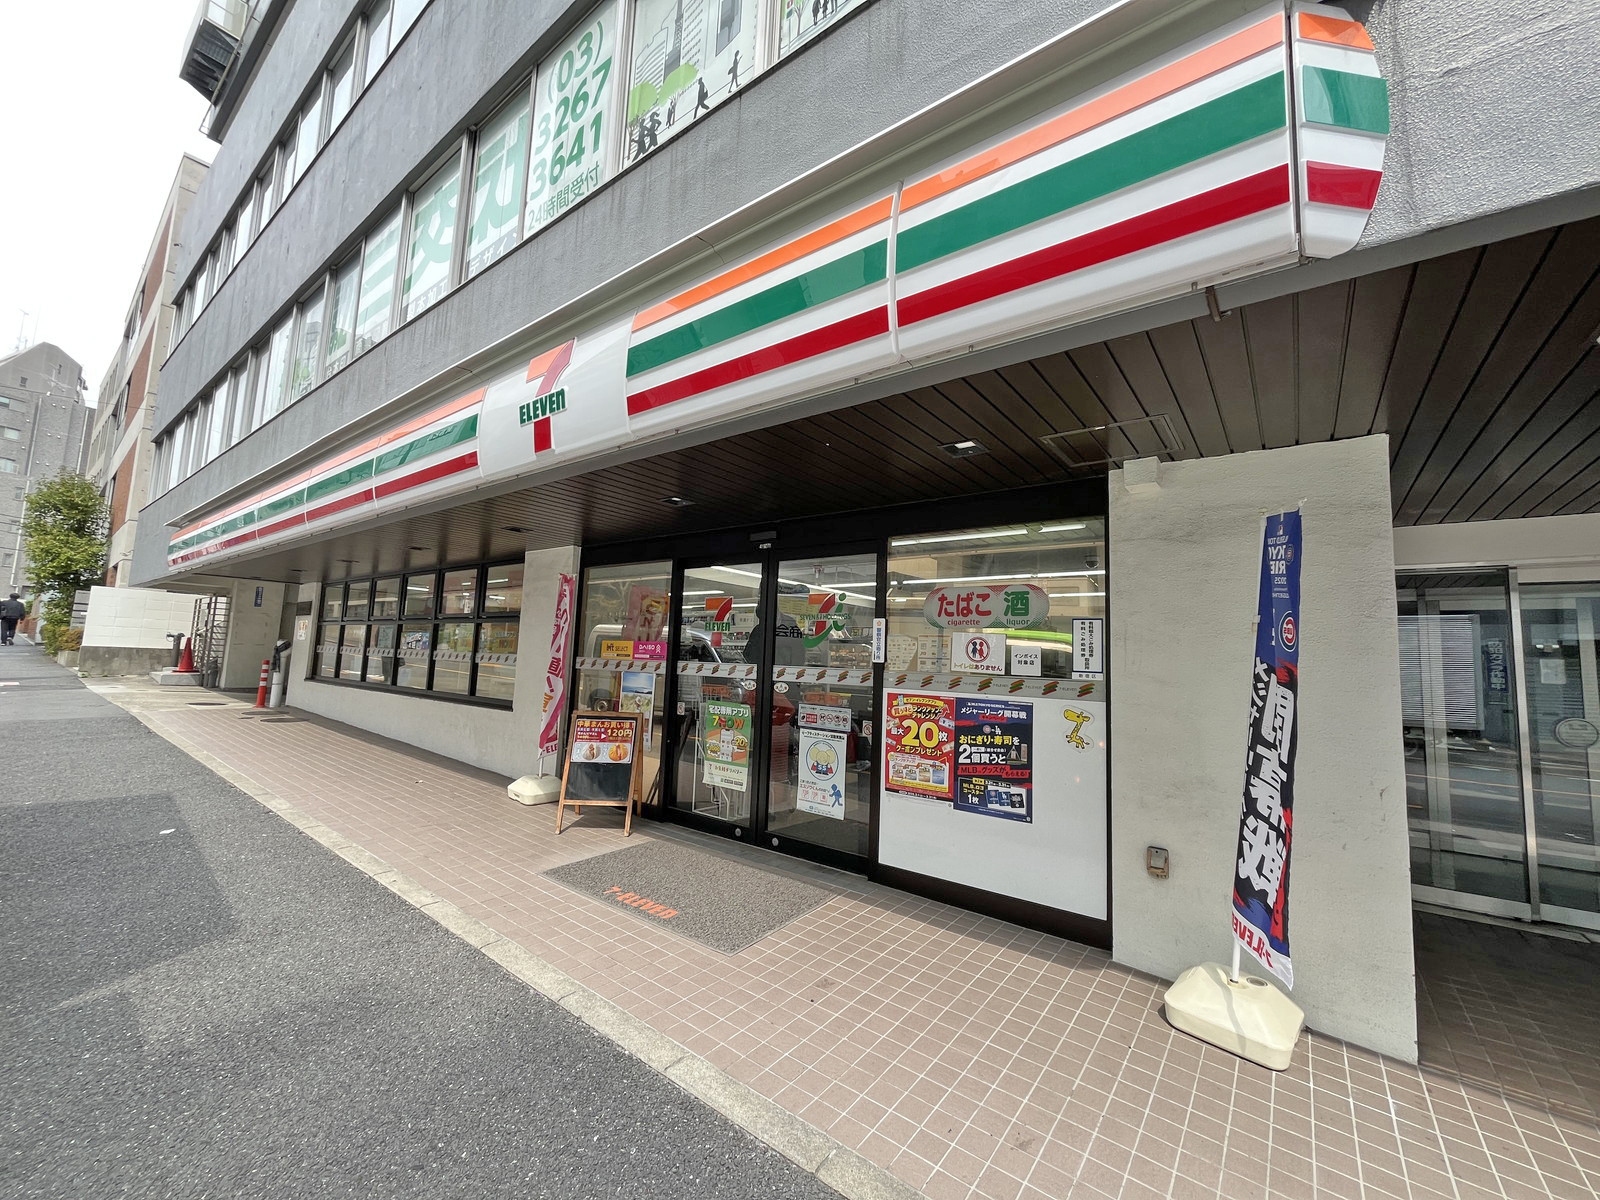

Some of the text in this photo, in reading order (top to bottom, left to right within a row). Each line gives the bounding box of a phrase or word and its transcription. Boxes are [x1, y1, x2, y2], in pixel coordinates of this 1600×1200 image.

[548, 20, 603, 104] (03)
[535, 56, 612, 156] 3267
[530, 110, 603, 193] 3641
[528, 161, 600, 230] 24時間受付
[938, 590, 1030, 618] たばこ 酒
[947, 618, 1030, 626] cigarette liquor
[953, 662, 1003, 672] トイレはありません
[961, 707, 1027, 719] メジャーリーグ開幕戦
[607, 728, 632, 737] 120円
[891, 719, 948, 748] 最大 20 枚
[959, 735, 1020, 745] おにぎり・寿司を
[896, 745, 942, 757] クーポンプレゼント
